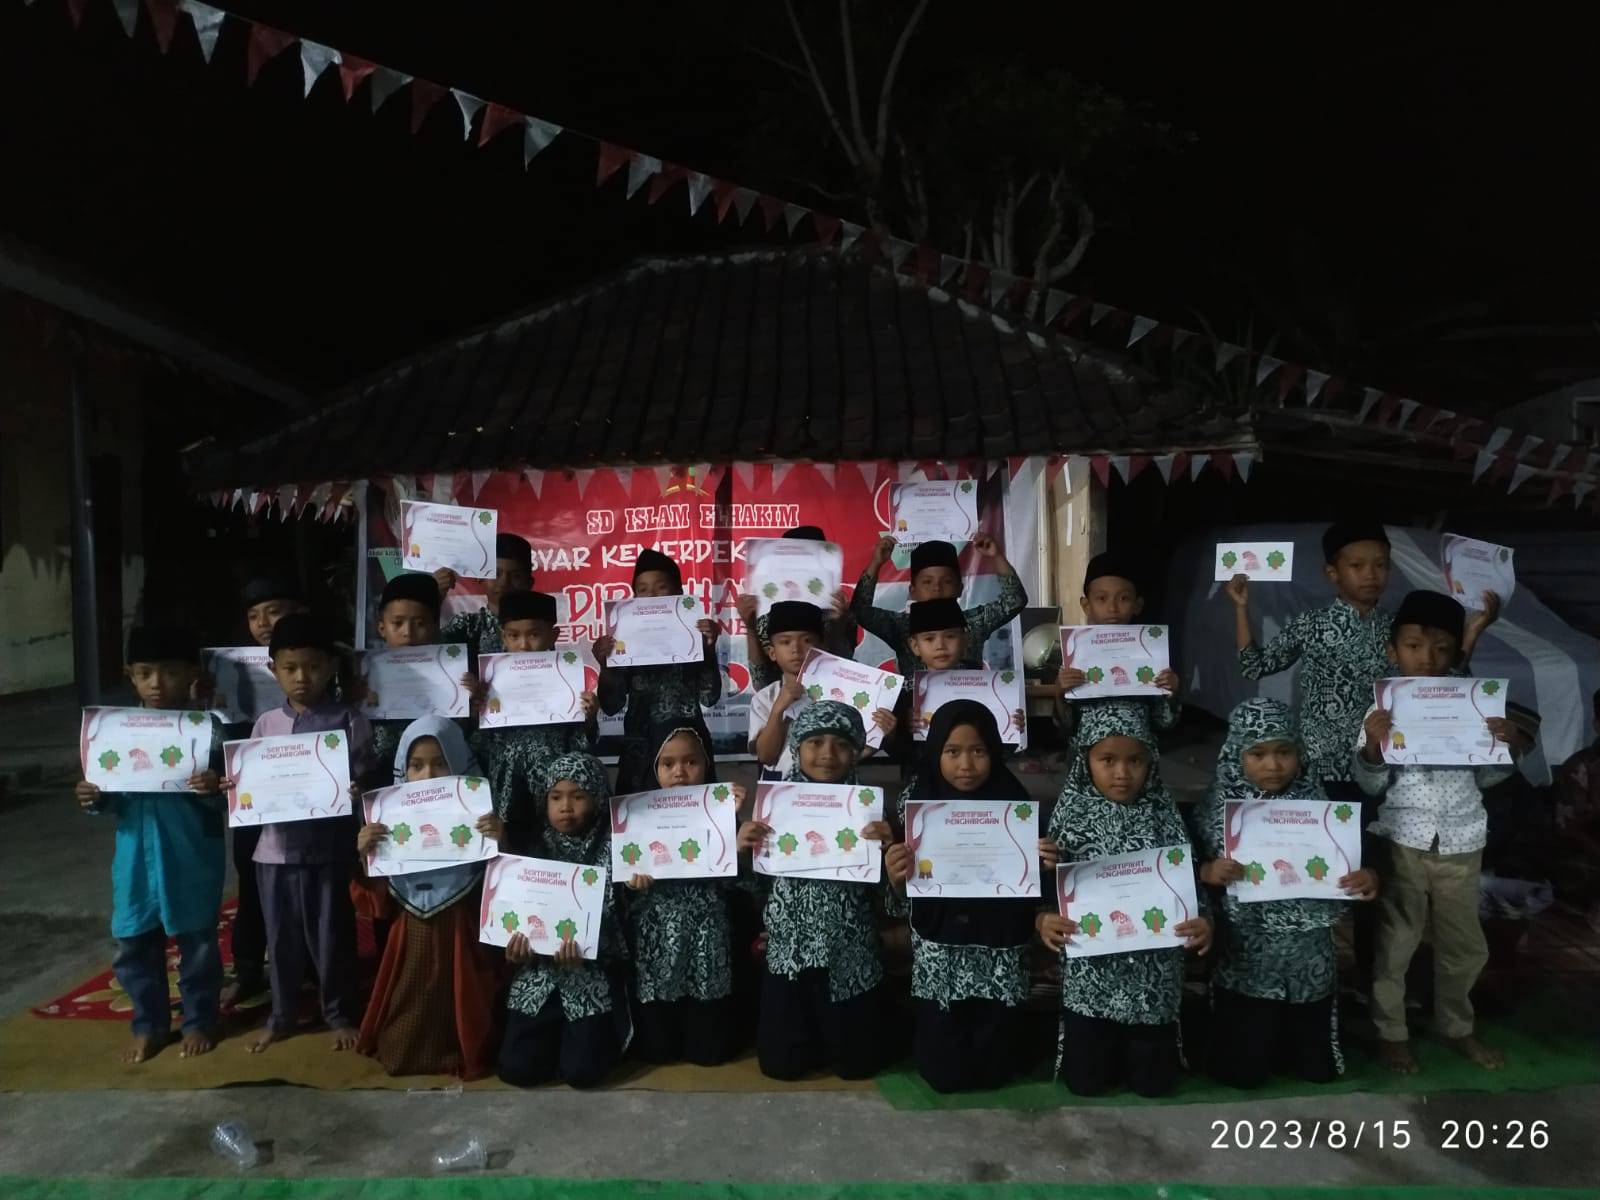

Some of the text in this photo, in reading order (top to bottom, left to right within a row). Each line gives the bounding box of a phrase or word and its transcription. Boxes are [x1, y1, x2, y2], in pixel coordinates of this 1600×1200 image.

[586, 509, 614, 535] SD
[624, 503, 690, 533] ISLAM
[601, 539, 747, 569] KEERDEK
